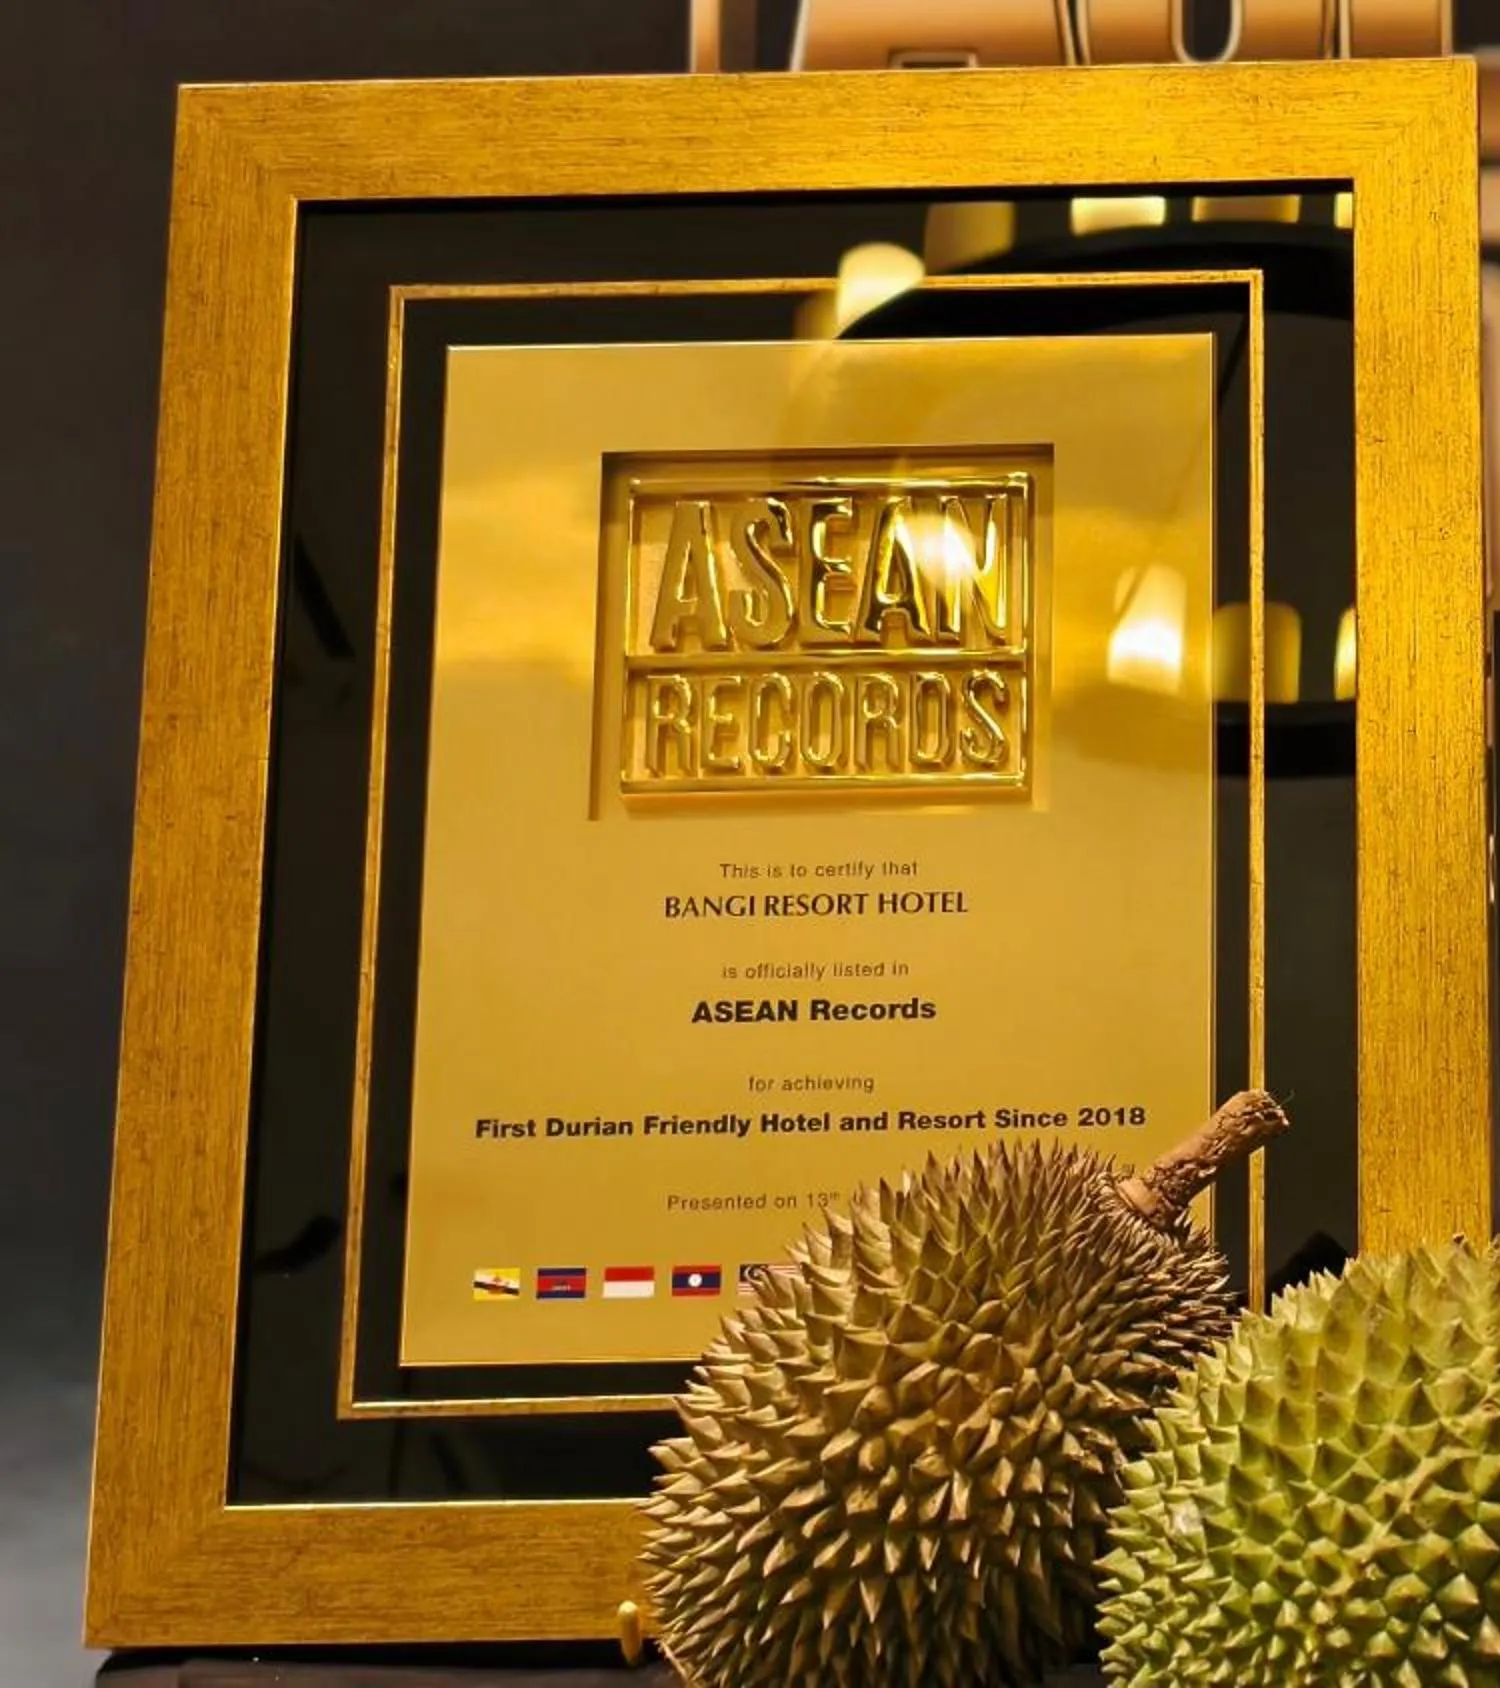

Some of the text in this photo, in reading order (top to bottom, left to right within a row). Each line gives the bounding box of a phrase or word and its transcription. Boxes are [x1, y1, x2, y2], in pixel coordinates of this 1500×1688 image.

[649, 494, 1009, 651] ASEAN
[644, 670, 1010, 777] RECORDS
[720, 860, 919, 881] This is to certify that
[664, 891, 969, 918] BANGI RESORT HOTEL
[721, 962, 910, 982] is officially listed in
[691, 998, 937, 1024] ASEAN Records
[748, 1075, 875, 1094] for achieving
[475, 1106, 1146, 1138] First Durian Friendly Hotel and Resort Since 2018
[667, 1193, 768, 1210] Presented
[773, 1195, 798, 1209] on
